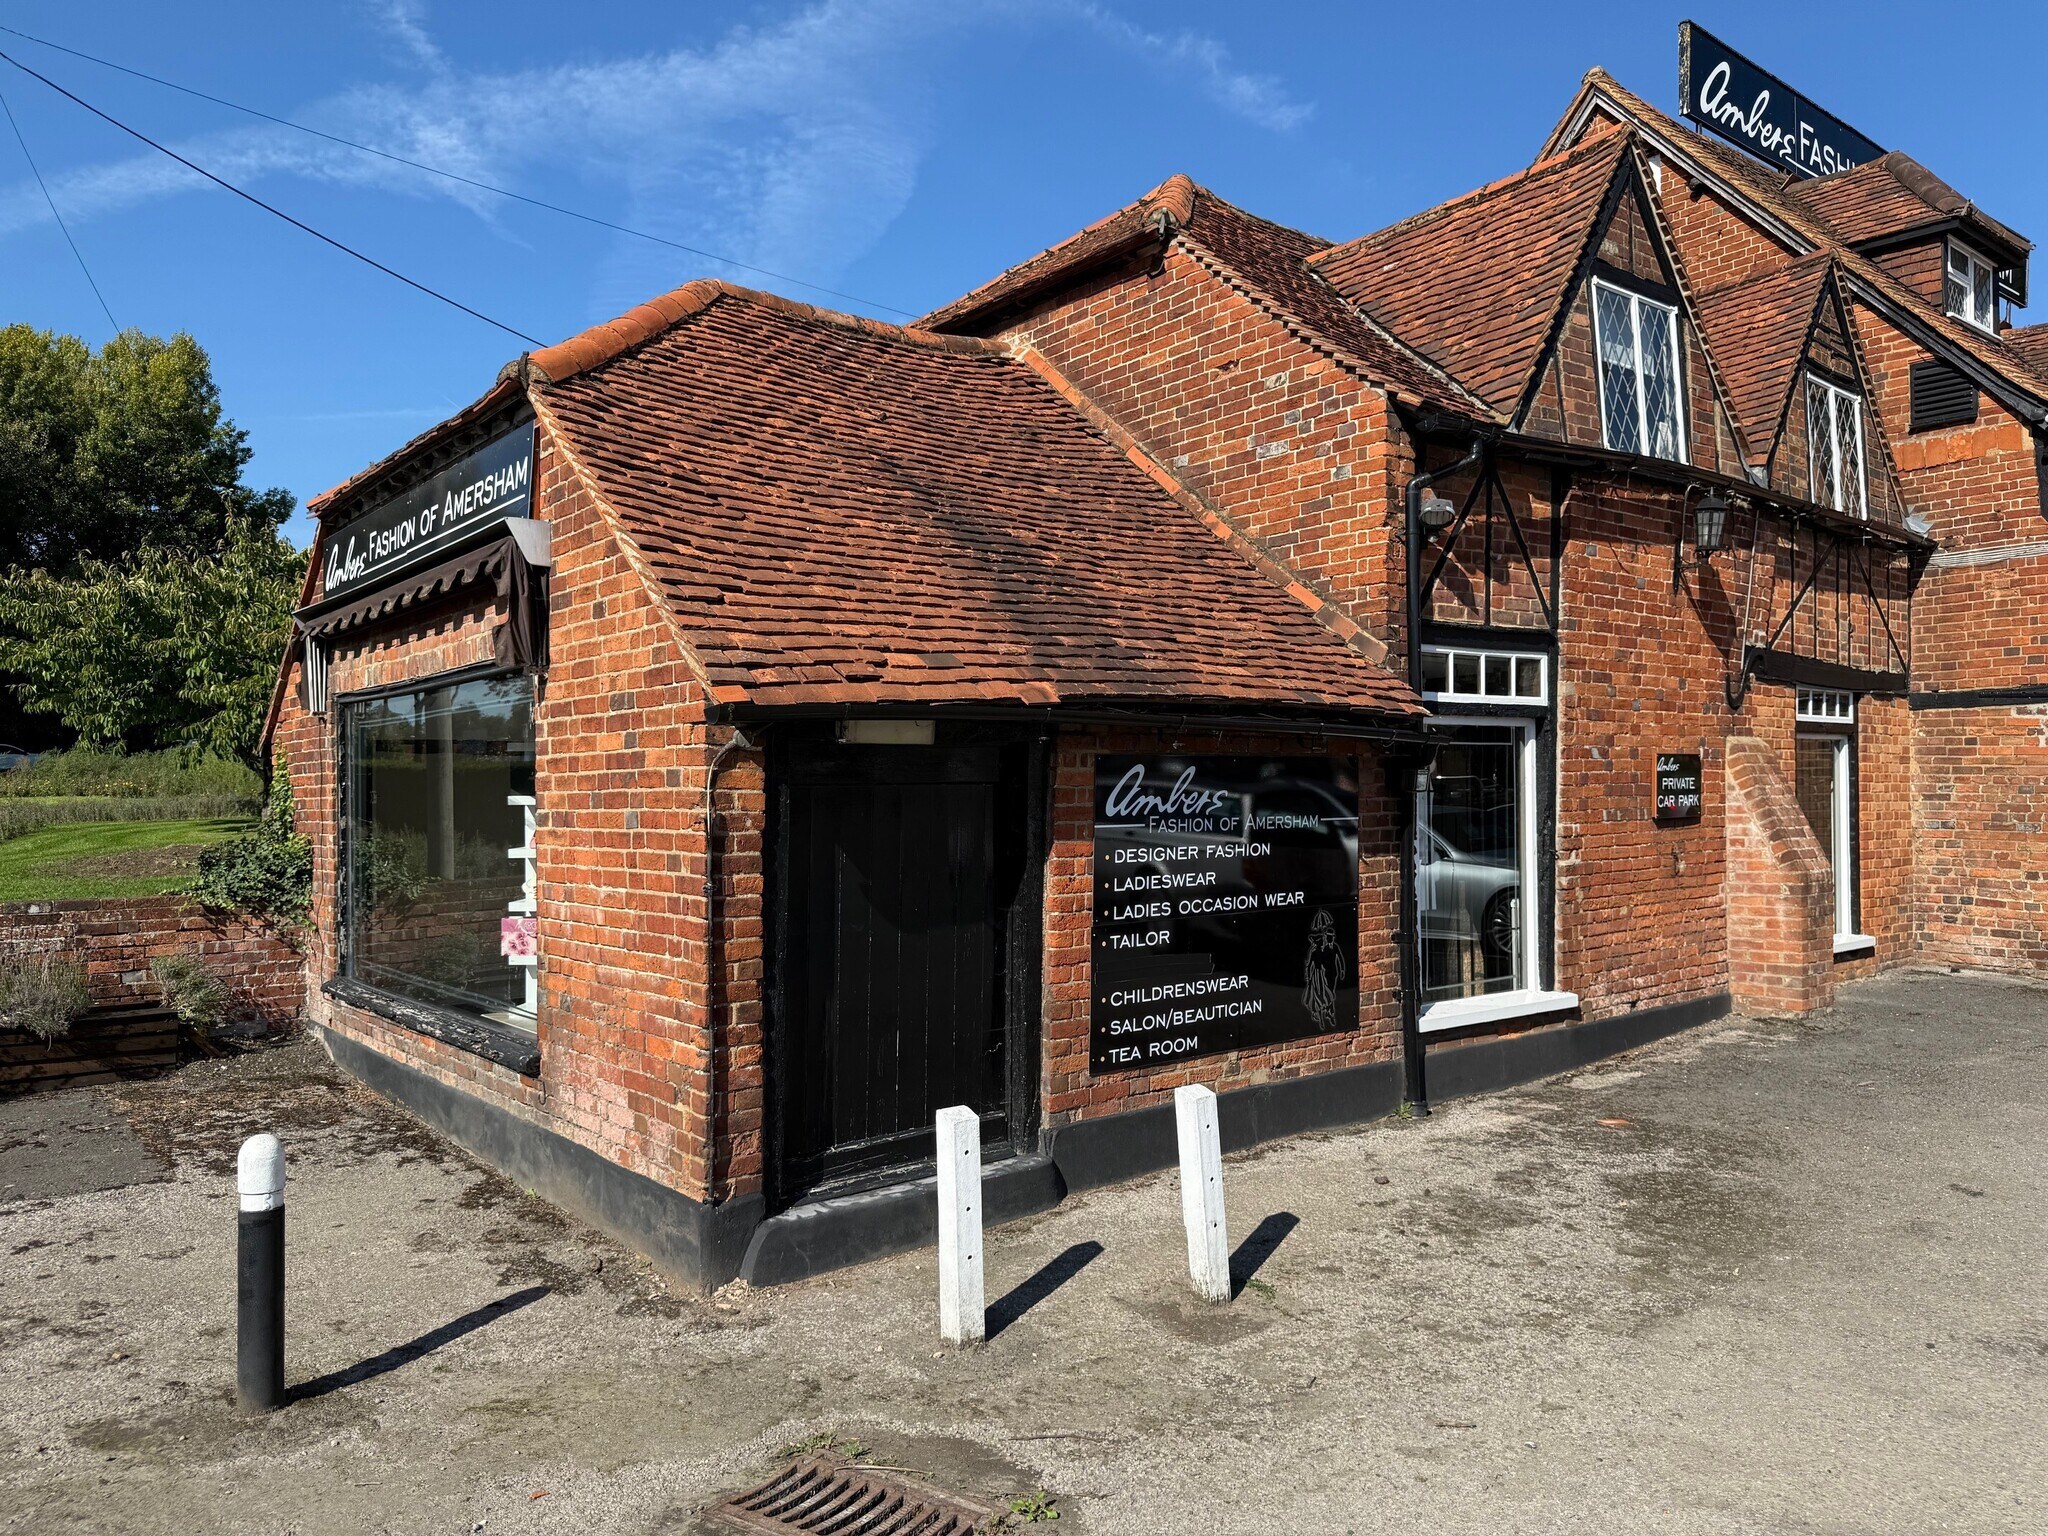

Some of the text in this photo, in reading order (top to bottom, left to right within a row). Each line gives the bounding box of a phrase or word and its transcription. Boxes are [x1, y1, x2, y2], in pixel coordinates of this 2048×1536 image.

[369, 517, 416, 562] FASHION
[420, 503, 439, 537] OF
[441, 456, 529, 527] AMERSHAM
[1662, 777, 1696, 790] PRIVATE
[1657, 794, 1699, 808] CAR PARK
[1148, 812, 1319, 834] FASHION OF AMERSHAM
[1114, 842, 1271, 864] DESIGNER FASHION
[1113, 872, 1216, 892] LADIESWEAR
[1113, 891, 1305, 920] LADIES OCCASION WEAR
[1110, 930, 1170, 950] TAILOR
[1110, 975, 1249, 1007] CHILDRENSWEAR
[1110, 999, 1262, 1036] SALON/BEAUTICIAN
[1108, 1036, 1198, 1064] TEA ROOM
